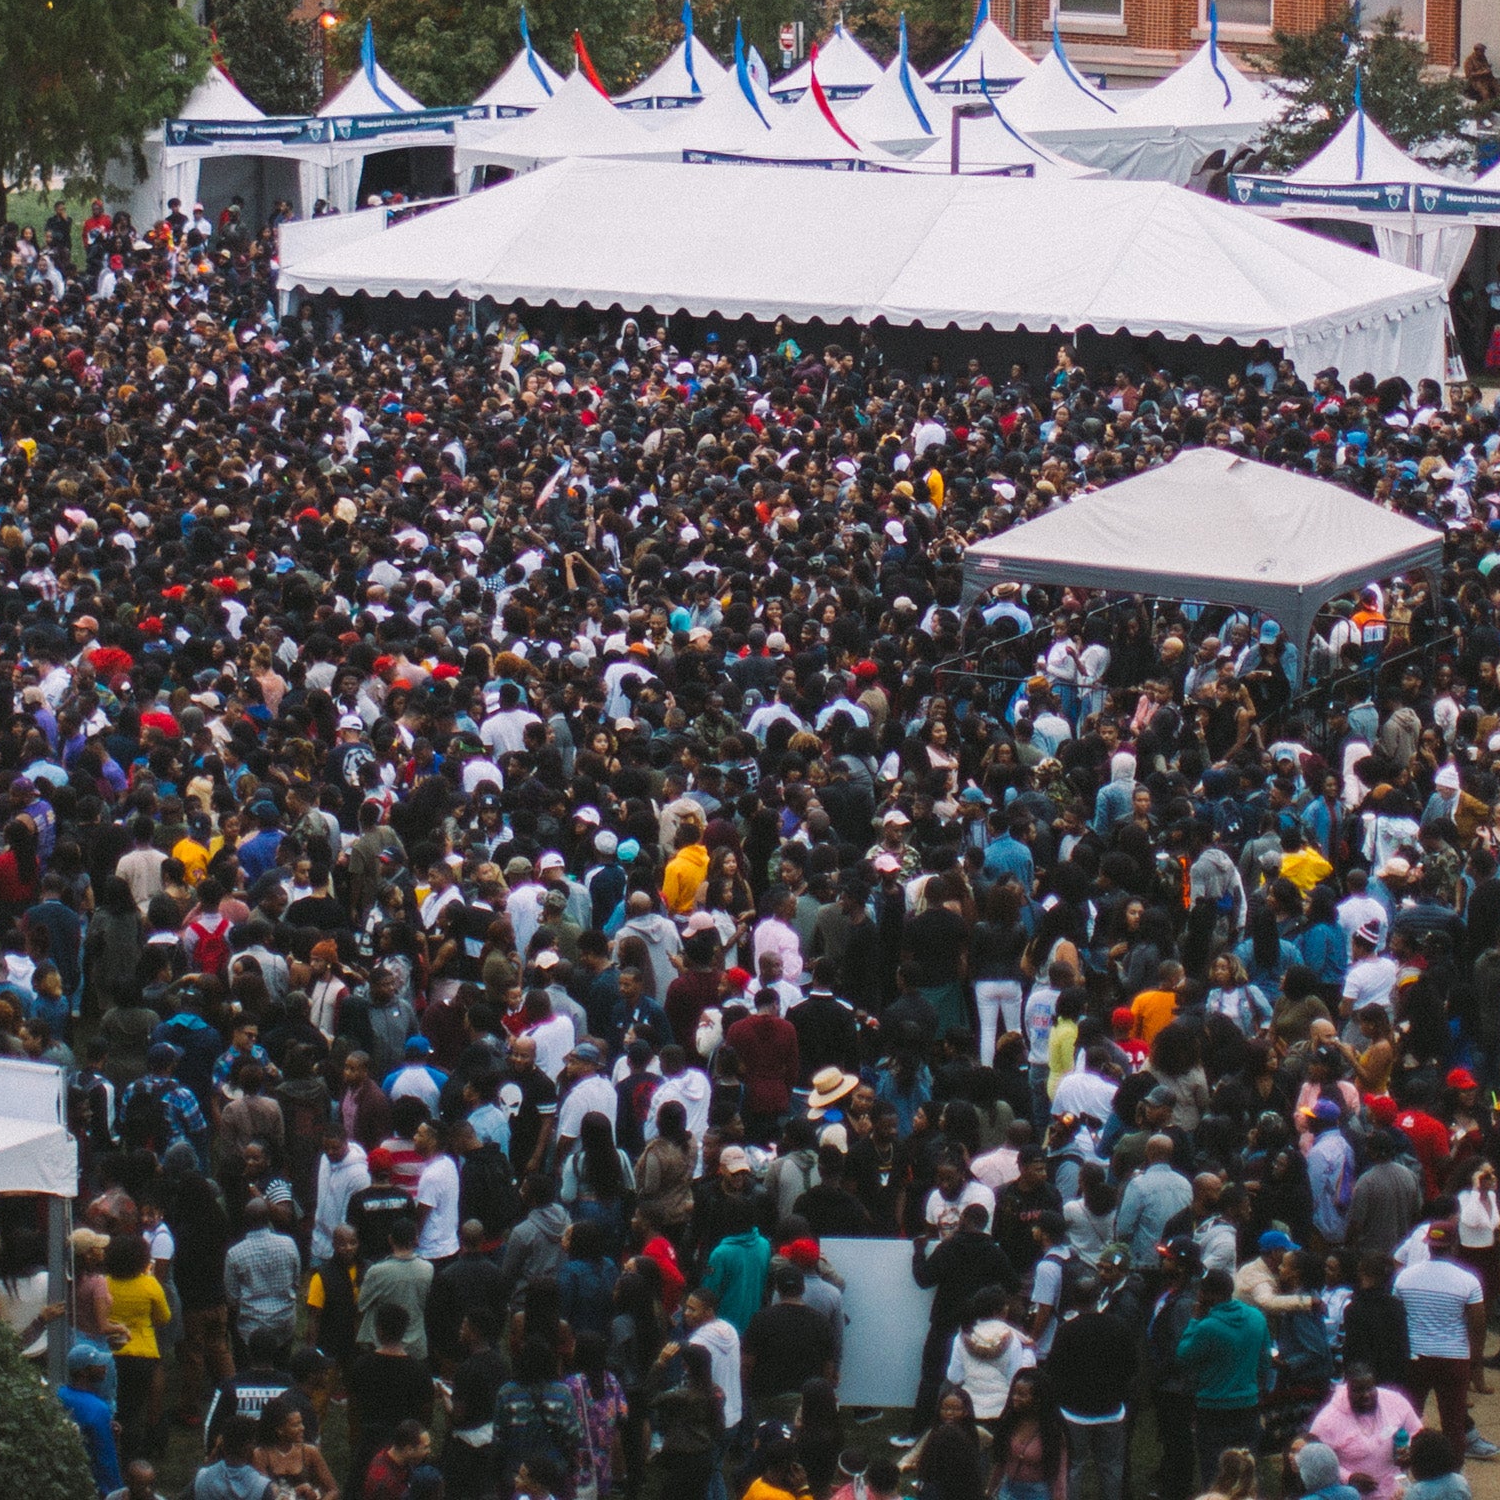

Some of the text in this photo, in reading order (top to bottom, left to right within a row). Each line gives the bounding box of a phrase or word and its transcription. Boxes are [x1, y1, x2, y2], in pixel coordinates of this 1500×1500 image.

[358, 118, 385, 129] Howard
[386, 115, 420, 128] University
[222, 126, 257, 135] University
[257, 126, 302, 135] Homecoming
[1260, 185, 1380, 199] Howard University Homecoming
[1446, 194, 1477, 203] Howard
